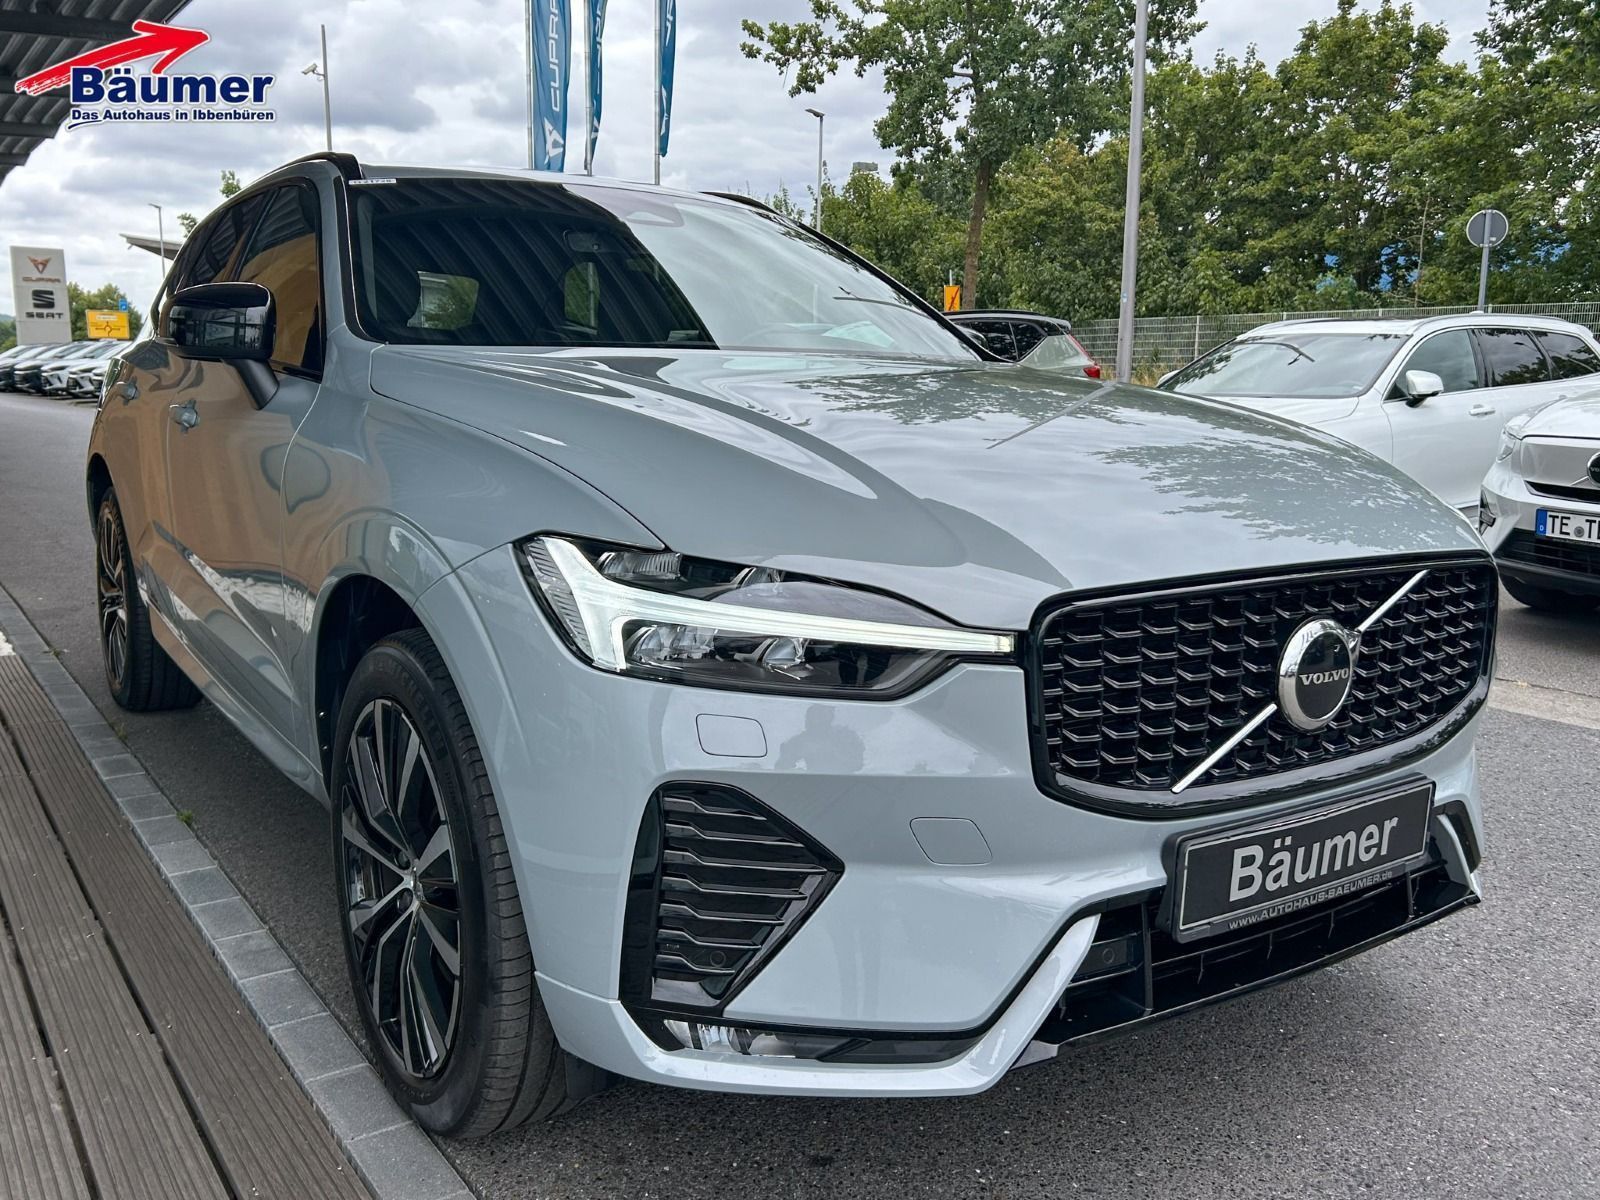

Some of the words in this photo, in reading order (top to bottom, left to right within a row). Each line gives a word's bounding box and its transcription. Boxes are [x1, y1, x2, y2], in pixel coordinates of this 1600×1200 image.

[25, 311, 64, 319] SEAT
[1549, 514, 1571, 536] TE
[1585, 518, 1600, 539] T
[1299, 668, 1349, 686] VOLVO
[1229, 816, 1399, 902] Bäumer
[1229, 870, 1393, 930] www.AUTOHAUS-BAEUMER.de
